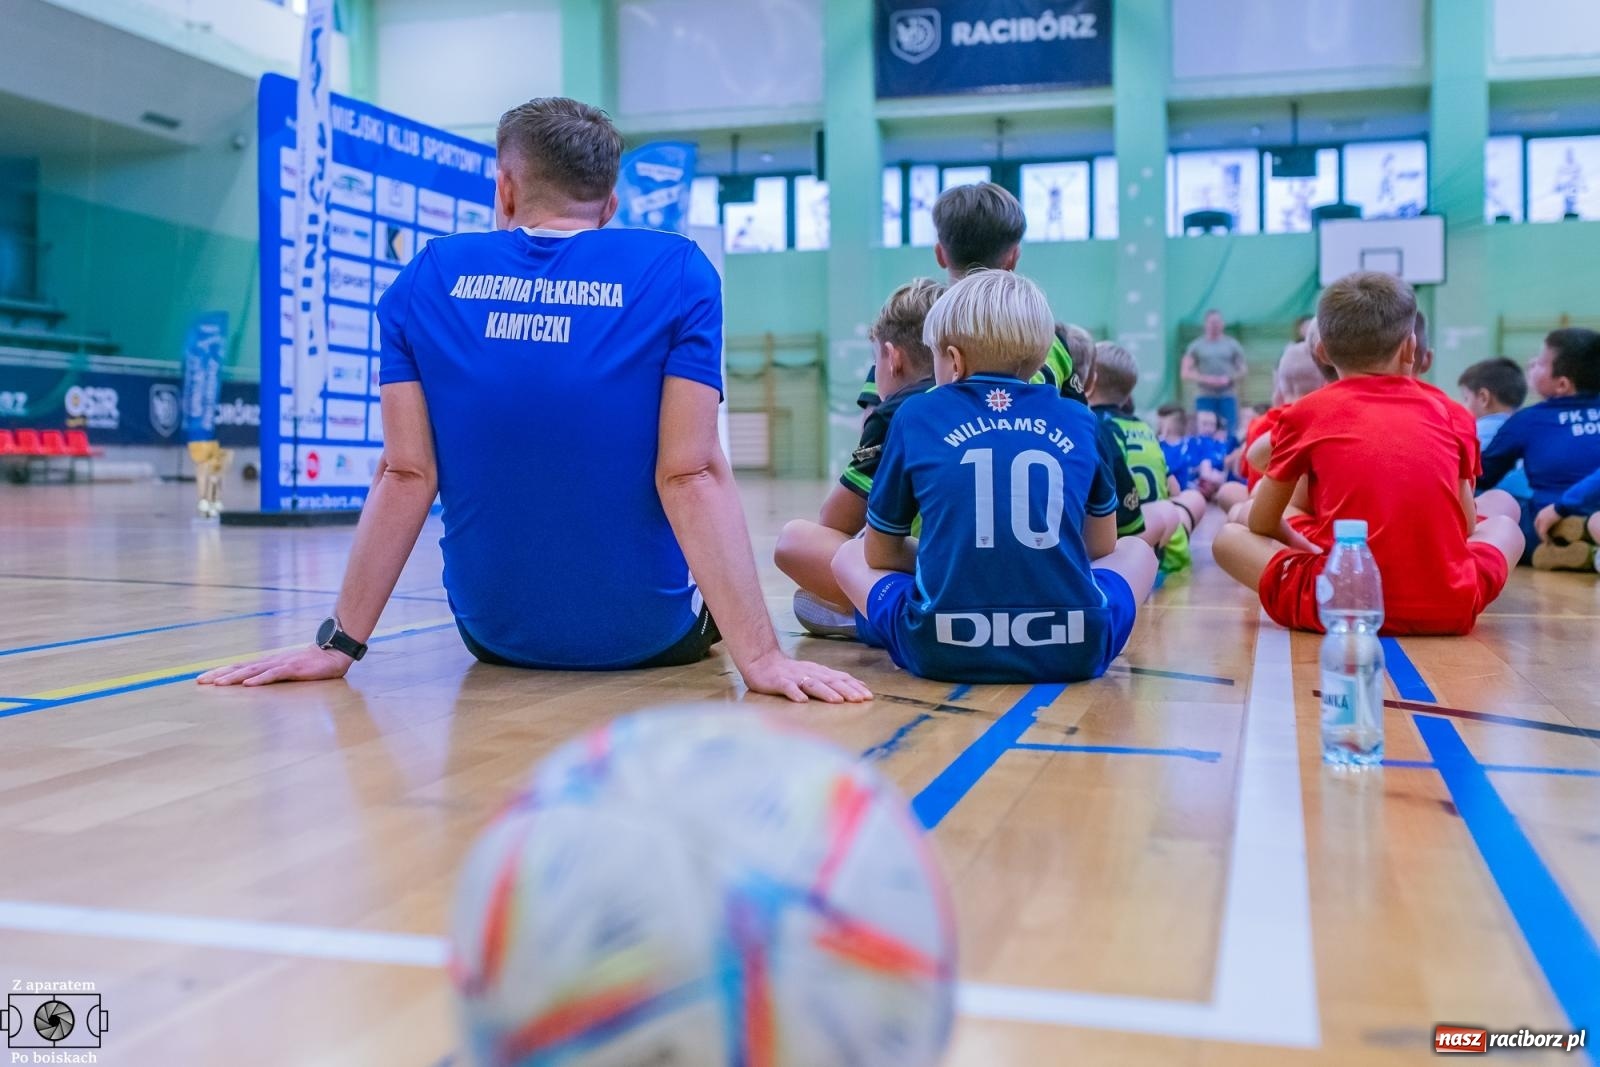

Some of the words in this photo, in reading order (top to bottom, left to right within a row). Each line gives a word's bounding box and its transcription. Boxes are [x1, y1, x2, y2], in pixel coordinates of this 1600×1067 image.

[951, 9, 1097, 46] RACIBÓRZ
[387, 124, 420, 156] KLUB
[422, 136, 482, 174] SPORTOWY
[450, 275, 532, 302] AKADEMIA
[532, 278, 624, 307] PIŁKARSKA
[485, 312, 571, 343] KAMYCZKI
[944, 417, 1047, 448] WILLIAMS
[1048, 428, 1075, 454] JR
[1559, 410, 1583, 425] FK
[959, 448, 1064, 550] 10
[935, 610, 1085, 647] DIGI
